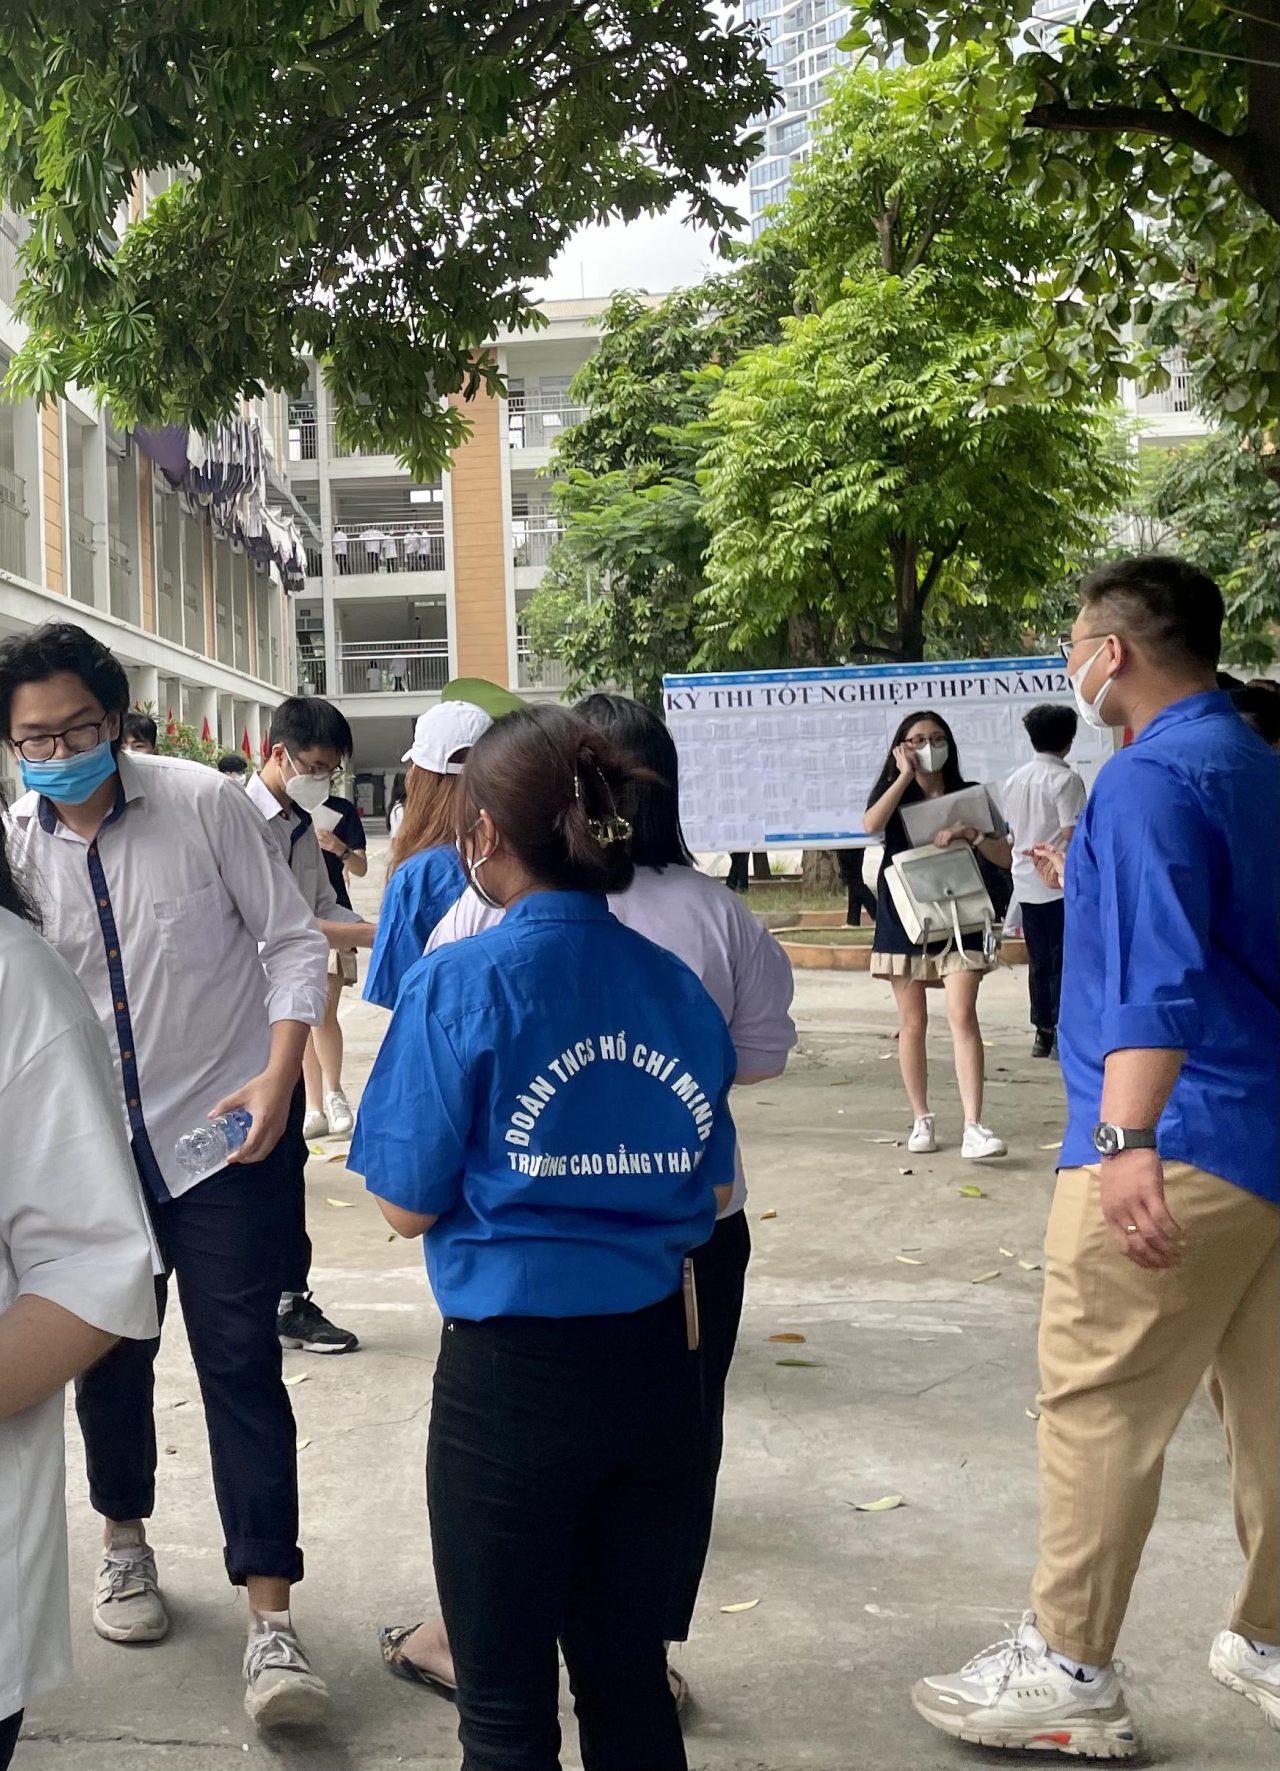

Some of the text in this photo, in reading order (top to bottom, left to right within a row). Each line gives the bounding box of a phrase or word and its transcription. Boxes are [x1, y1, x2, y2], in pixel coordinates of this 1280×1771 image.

[666, 686, 701, 711] KỲ
[709, 689, 753, 709] THI
[921, 677, 990, 699] THPT
[504, 1075, 557, 1147] ĐOÀN
[547, 1037, 595, 1083] TNCS
[632, 1043, 680, 1083] CHÍ
[670, 1072, 714, 1141] MINH
[507, 1152, 567, 1177] TRƯỜNG
[570, 1153, 603, 1176] CAO
[605, 1144, 652, 1174] ĐẲNG
[653, 1152, 664, 1173] Y
[667, 1147, 692, 1173] HÀ
